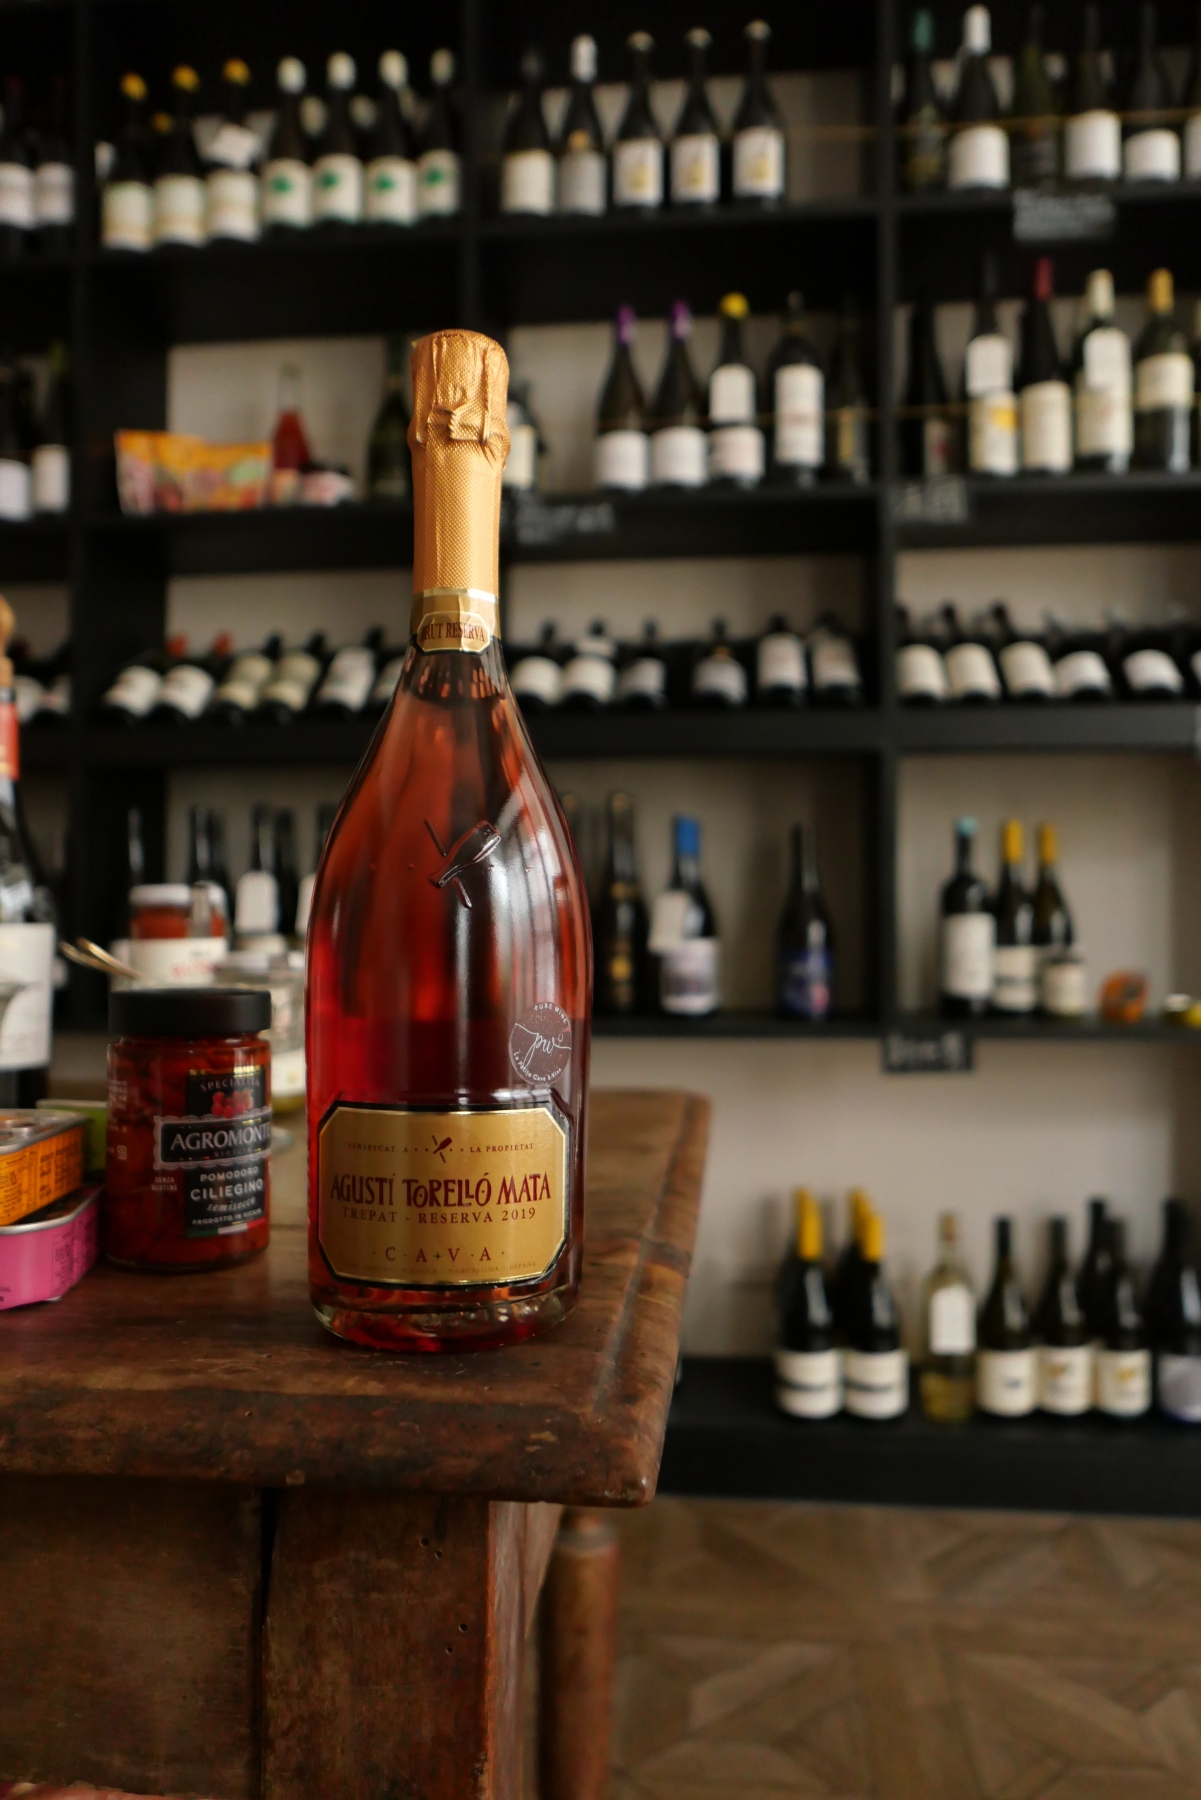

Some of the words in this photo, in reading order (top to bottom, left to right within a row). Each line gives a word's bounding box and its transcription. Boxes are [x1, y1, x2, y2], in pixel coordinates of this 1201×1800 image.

[421, 623, 443, 642] BRUT
[445, 621, 485, 642] RESERVA
[534, 1002, 553, 1011] PURE
[554, 1006, 568, 1024] WINE
[347, 1142, 396, 1153] VINIFICAT
[485, 1142, 534, 1153] PROPIETAT
[200, 1166, 259, 1182] POMODORO
[190, 1178, 263, 1201] CILIEGINO
[329, 1172, 396, 1206] AGUSTÍ
[496, 1170, 552, 1205] MATA
[342, 1206, 398, 1222] TREPAT
[418, 1212, 493, 1224] RESERVA
[502, 1207, 536, 1222] 2019
